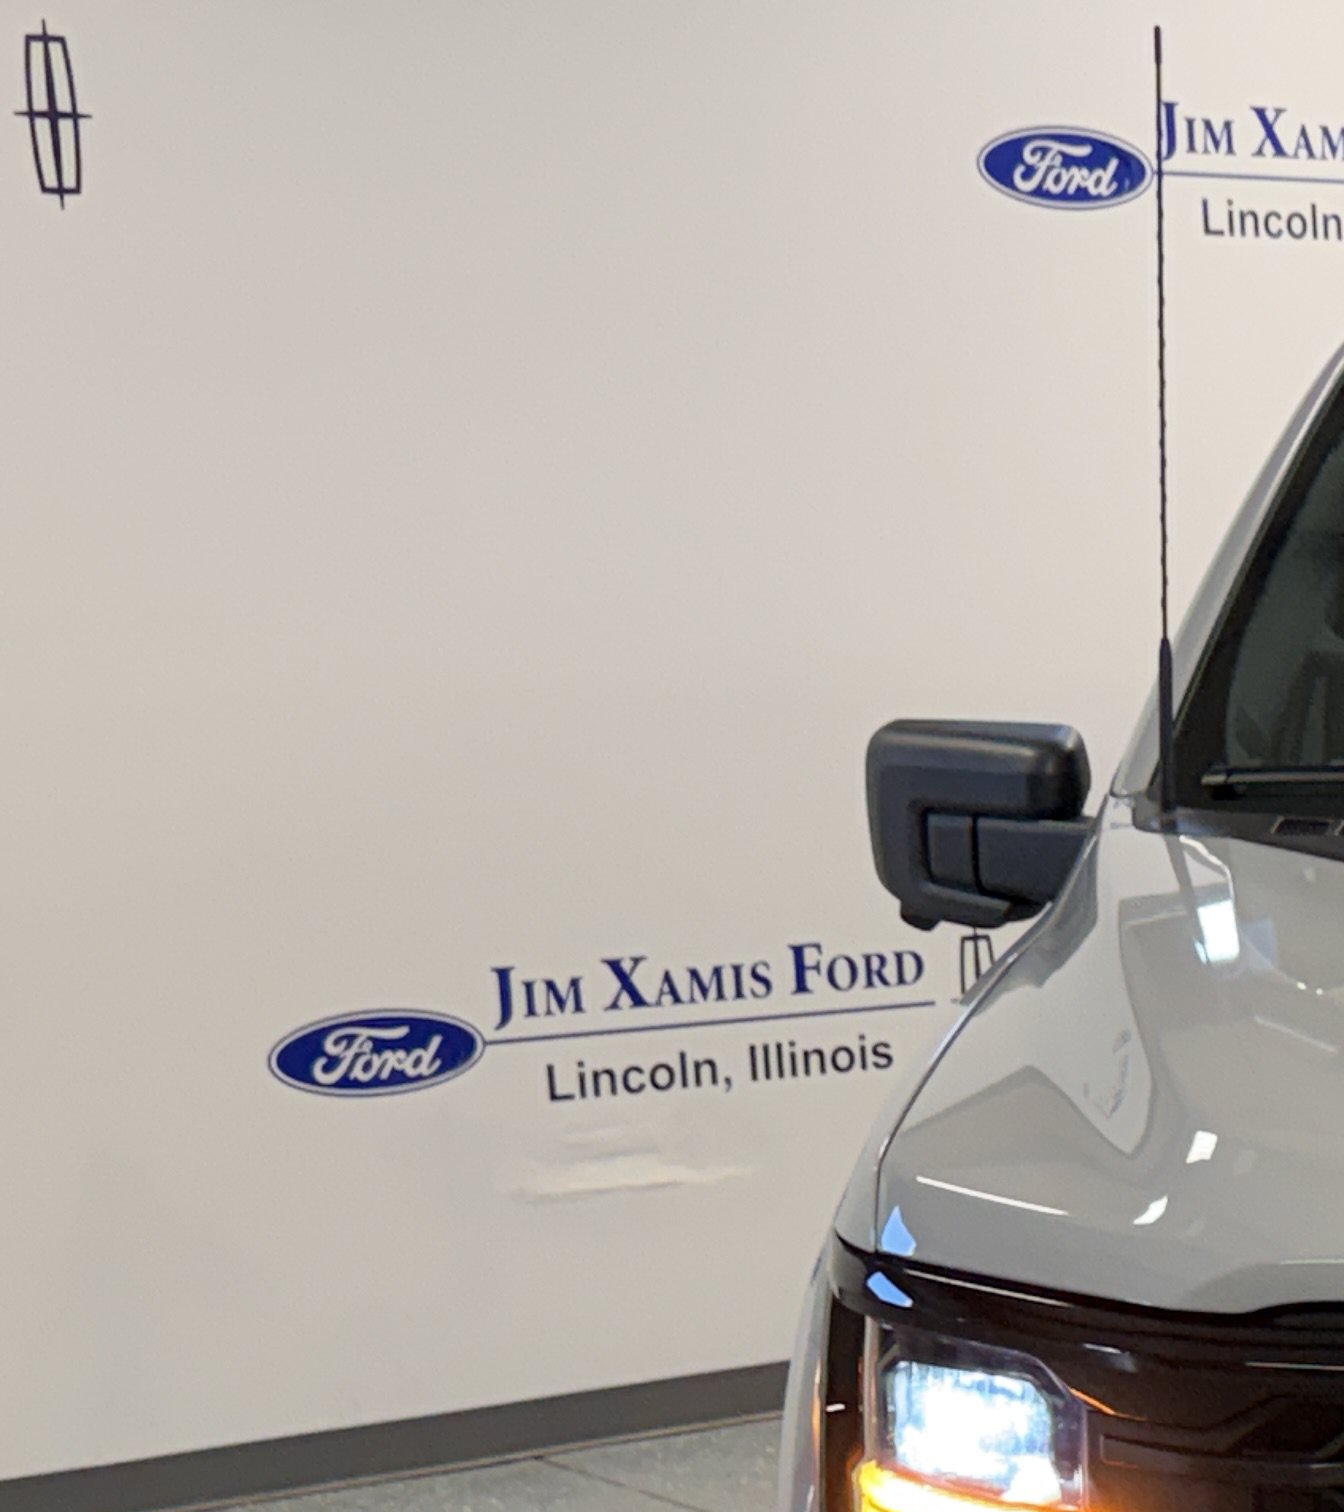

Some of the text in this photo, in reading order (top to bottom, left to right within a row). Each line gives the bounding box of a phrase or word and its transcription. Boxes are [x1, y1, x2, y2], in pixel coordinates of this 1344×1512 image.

[1162, 101, 1234, 161] JIM
[1013, 138, 1118, 198] Ford
[491, 942, 924, 1031] JIM XAMIS FORD
[312, 1025, 443, 1085] Ford
[547, 1034, 894, 1102] Lincoln, Illinois
